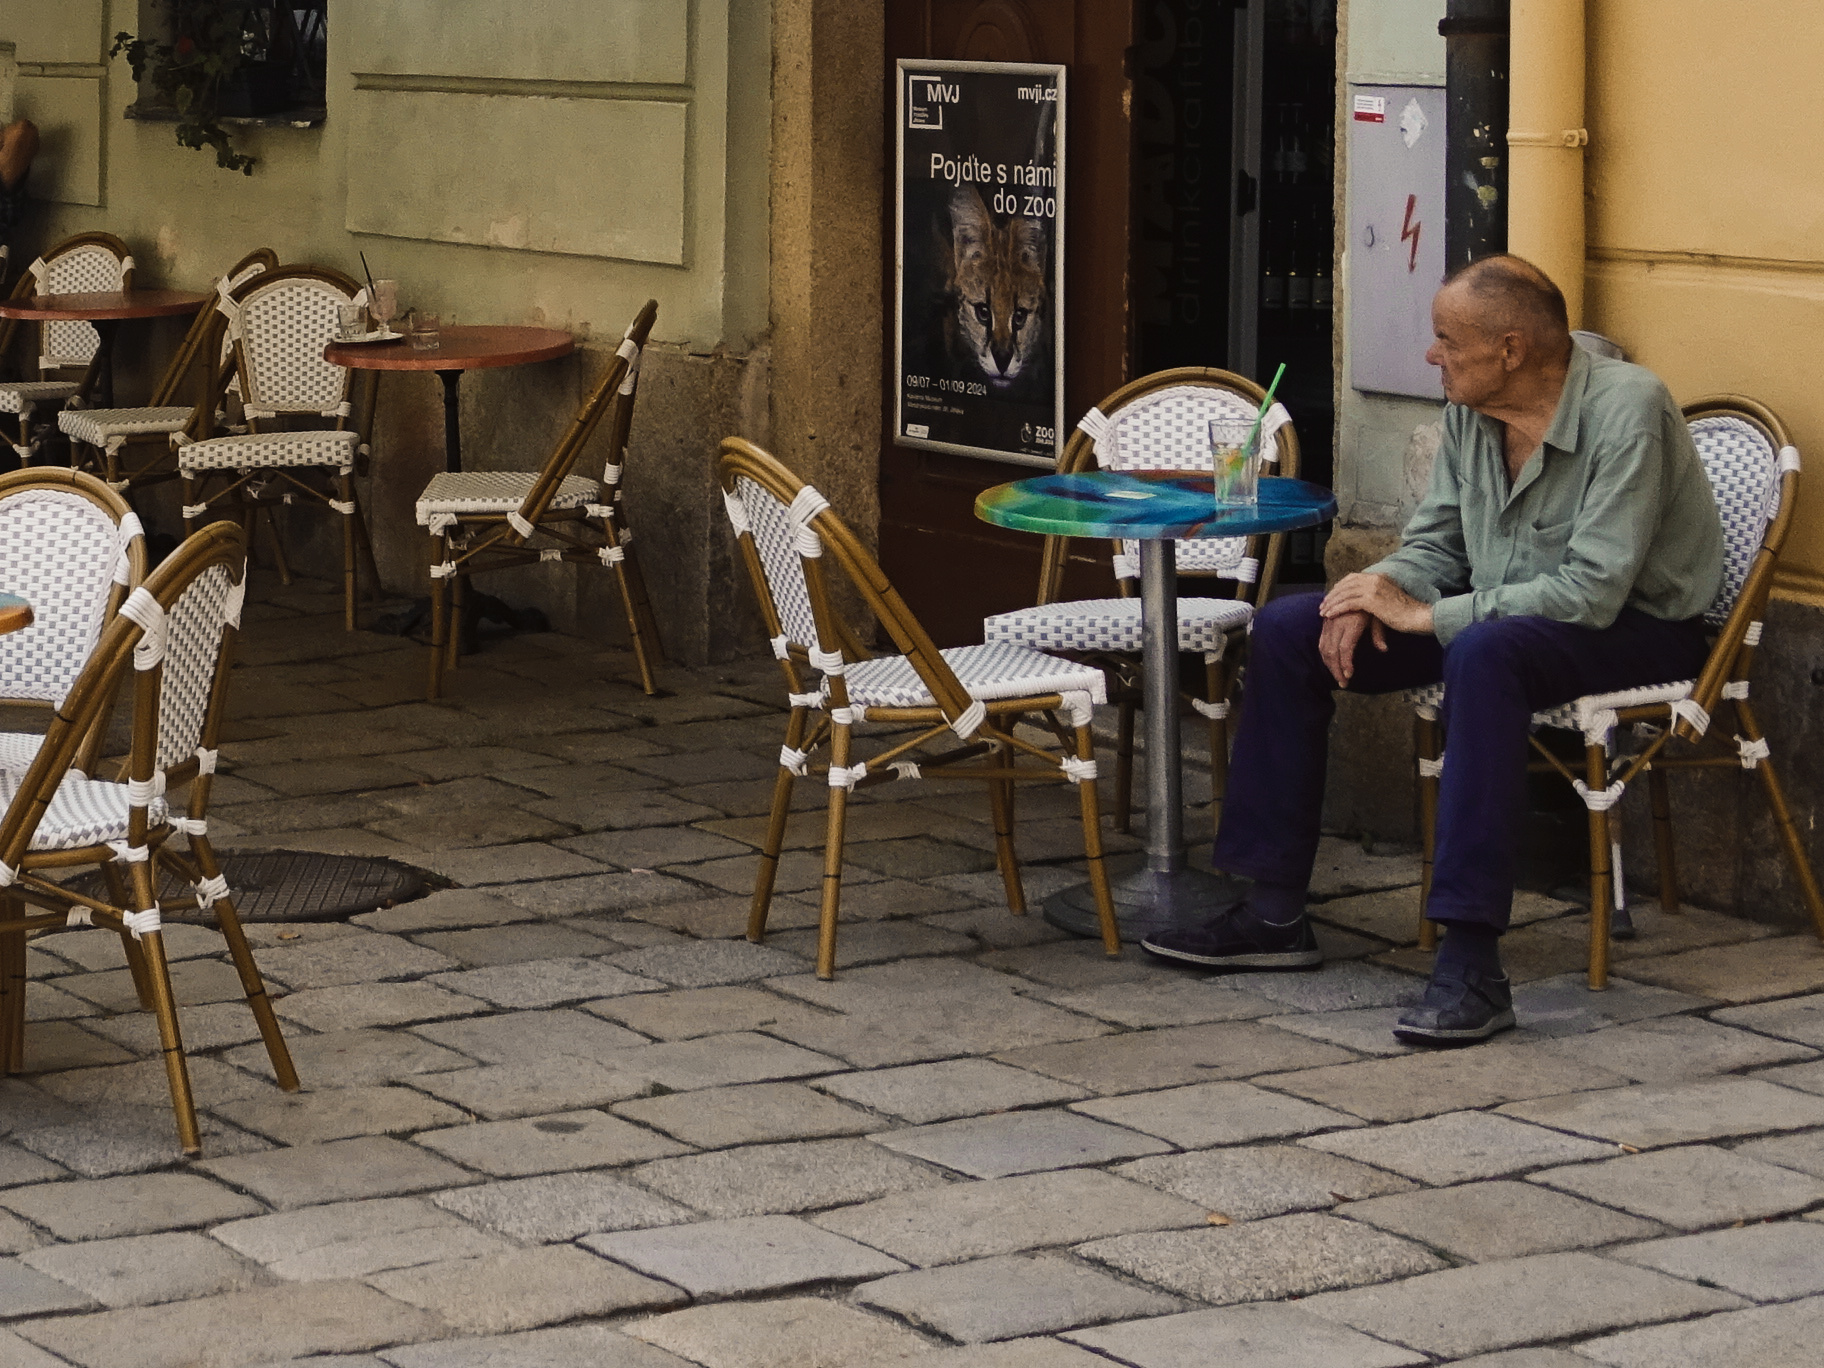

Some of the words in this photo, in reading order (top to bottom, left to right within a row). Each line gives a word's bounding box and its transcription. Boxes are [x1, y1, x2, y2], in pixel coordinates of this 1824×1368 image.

[926, 83, 960, 104] MVJ
[1017, 84, 1057, 104] mvji.cz
[930, 153, 992, 188] Pojďte
[996, 163, 1008, 184] s
[1013, 159, 1056, 188] námi
[993, 187, 1017, 215] do
[1023, 196, 1056, 218] zoo
[966, 382, 988, 396] 2024
[1035, 425, 1055, 439] ZOO
